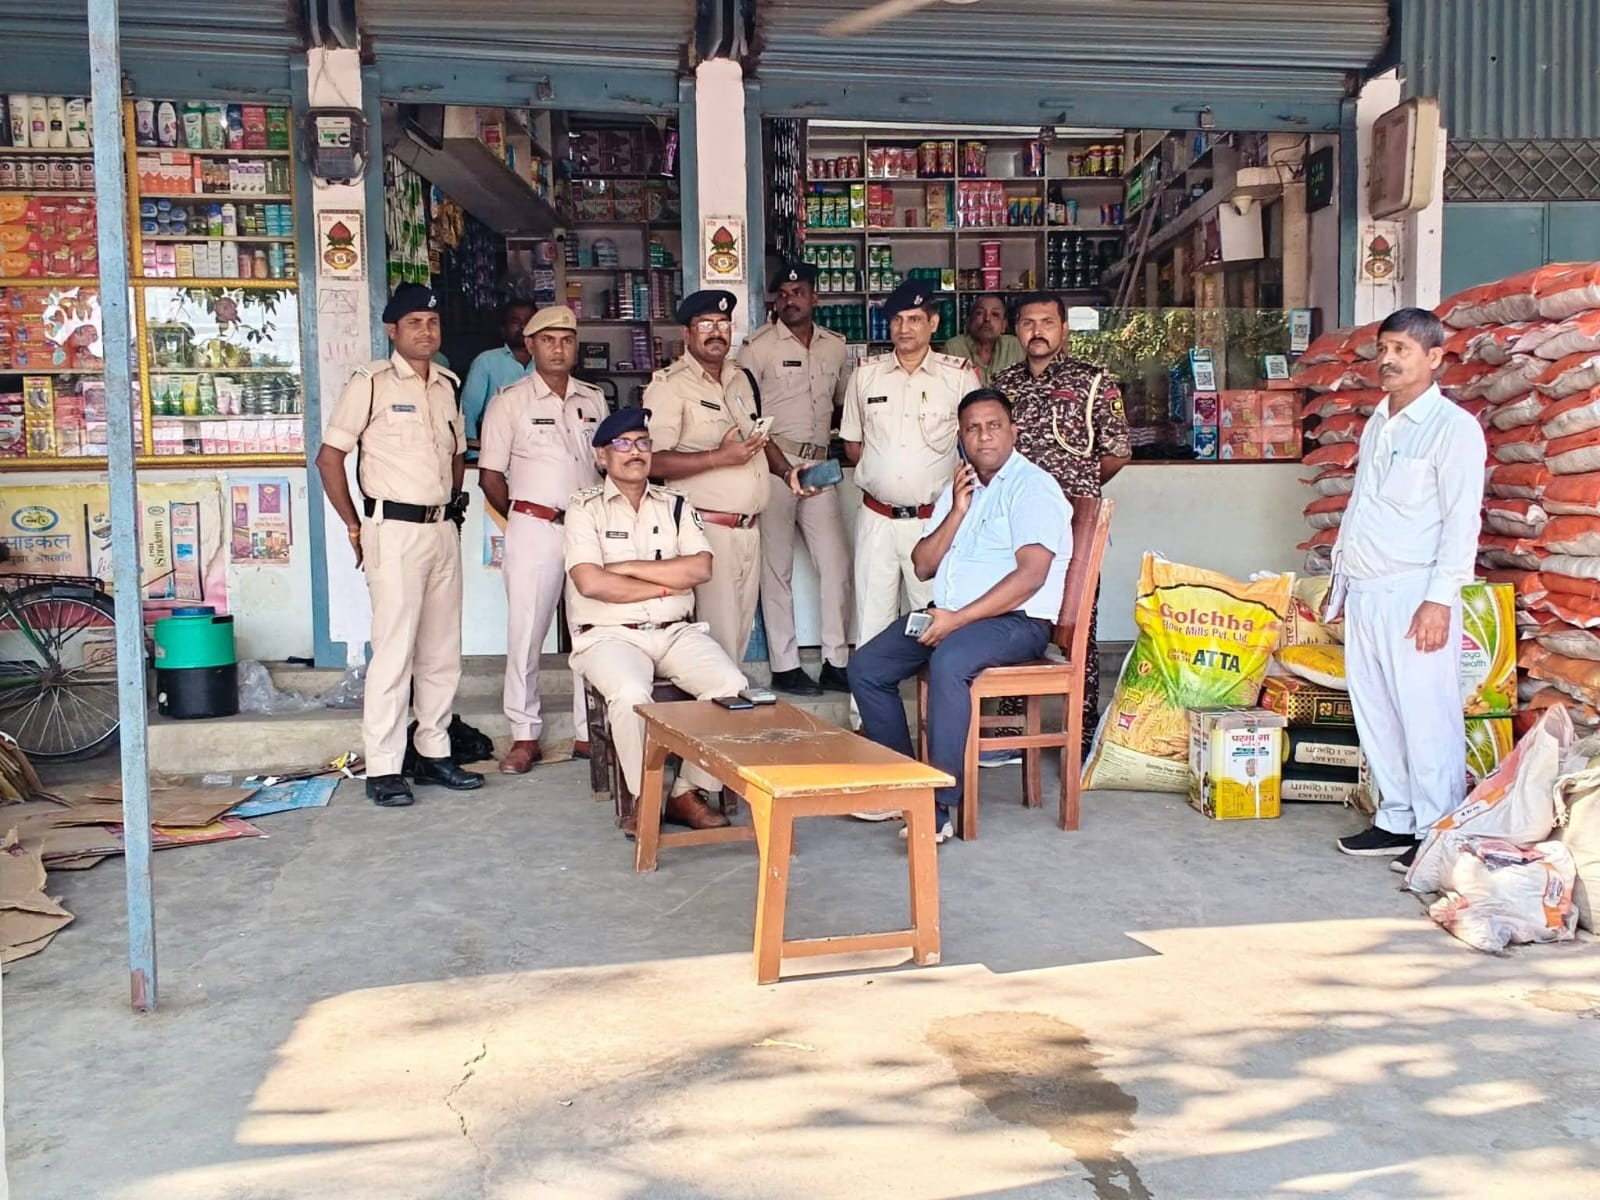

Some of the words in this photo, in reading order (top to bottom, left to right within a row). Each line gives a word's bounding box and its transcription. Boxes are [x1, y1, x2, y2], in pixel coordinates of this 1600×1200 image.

[1160, 602, 1254, 632] Golchha
[1185, 626, 1209, 637] Mills
[1212, 628, 1229, 640] Pvt.
[1192, 649, 1241, 673] ATTA
